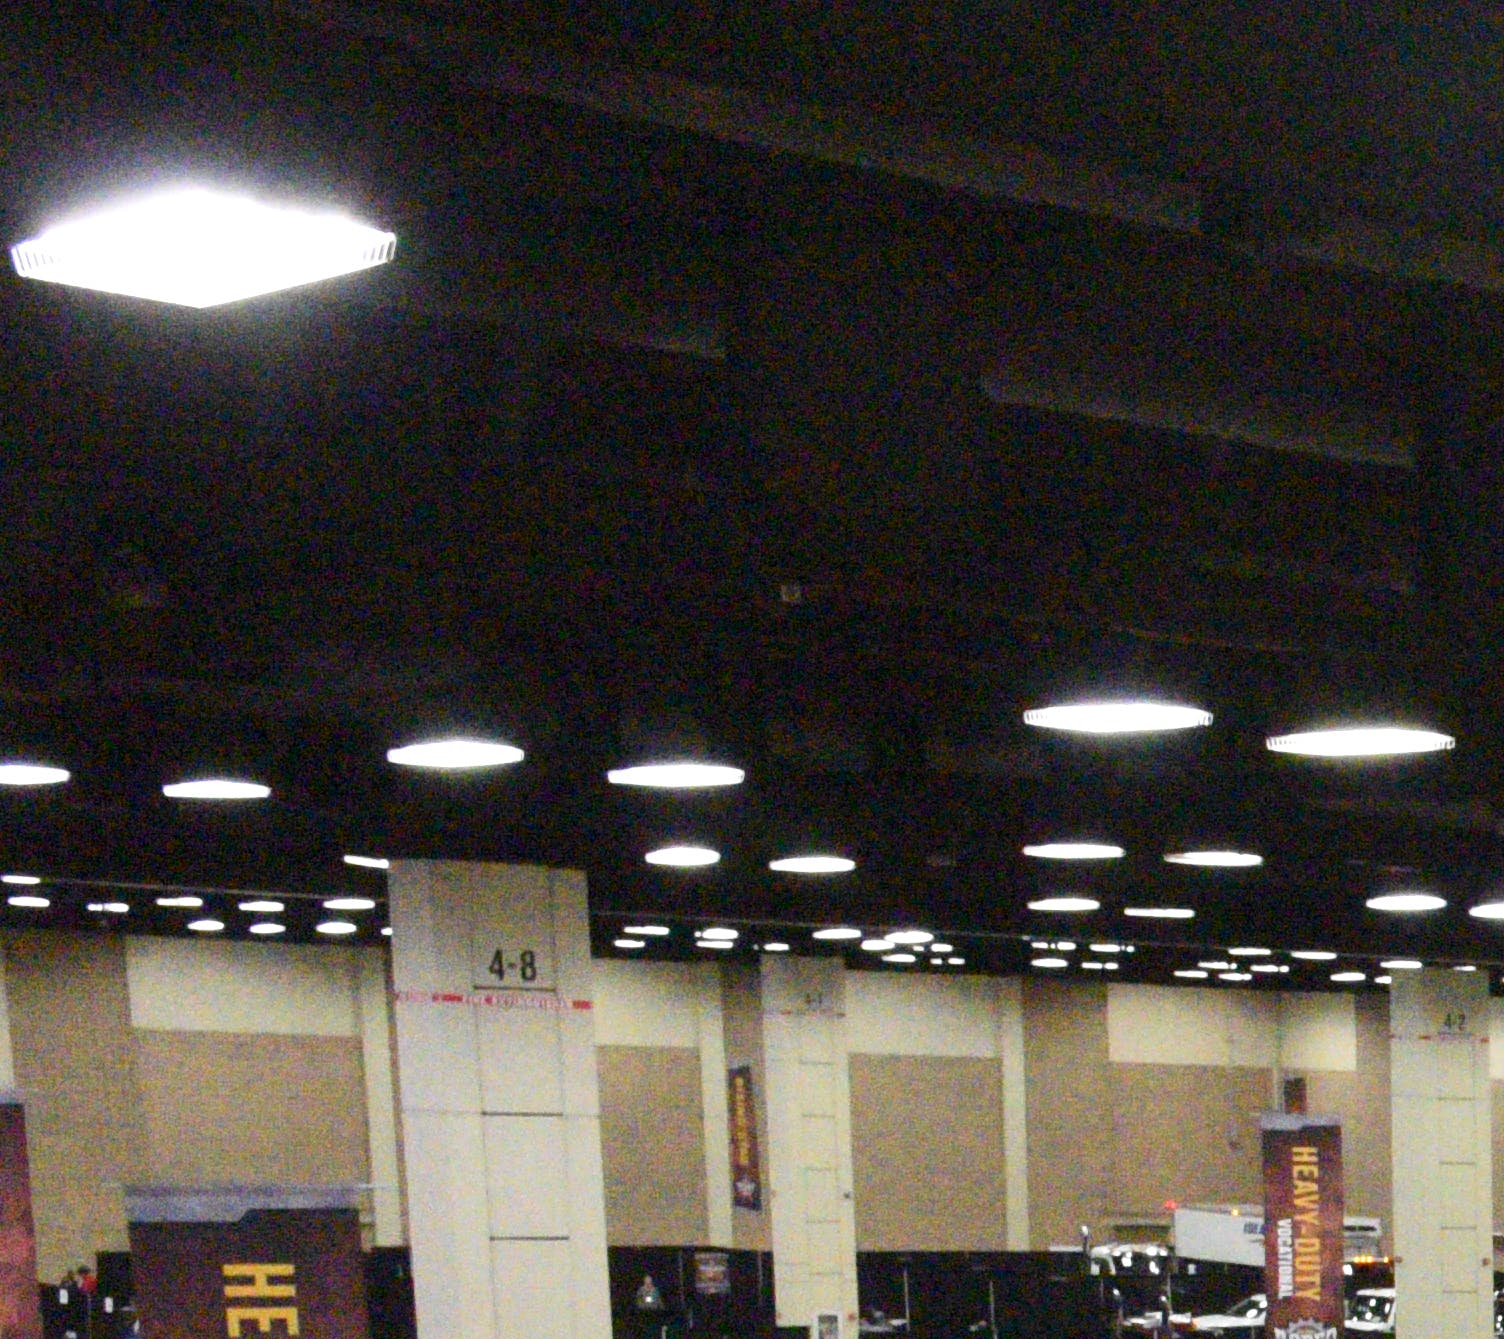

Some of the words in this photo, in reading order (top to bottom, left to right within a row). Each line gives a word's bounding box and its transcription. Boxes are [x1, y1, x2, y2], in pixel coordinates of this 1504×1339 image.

[489, 948, 538, 983] 4-8
[1277, 1218, 1292, 1300] VOCATIONAL
[1292, 1145, 1321, 1301] HEAVY-DUTY
